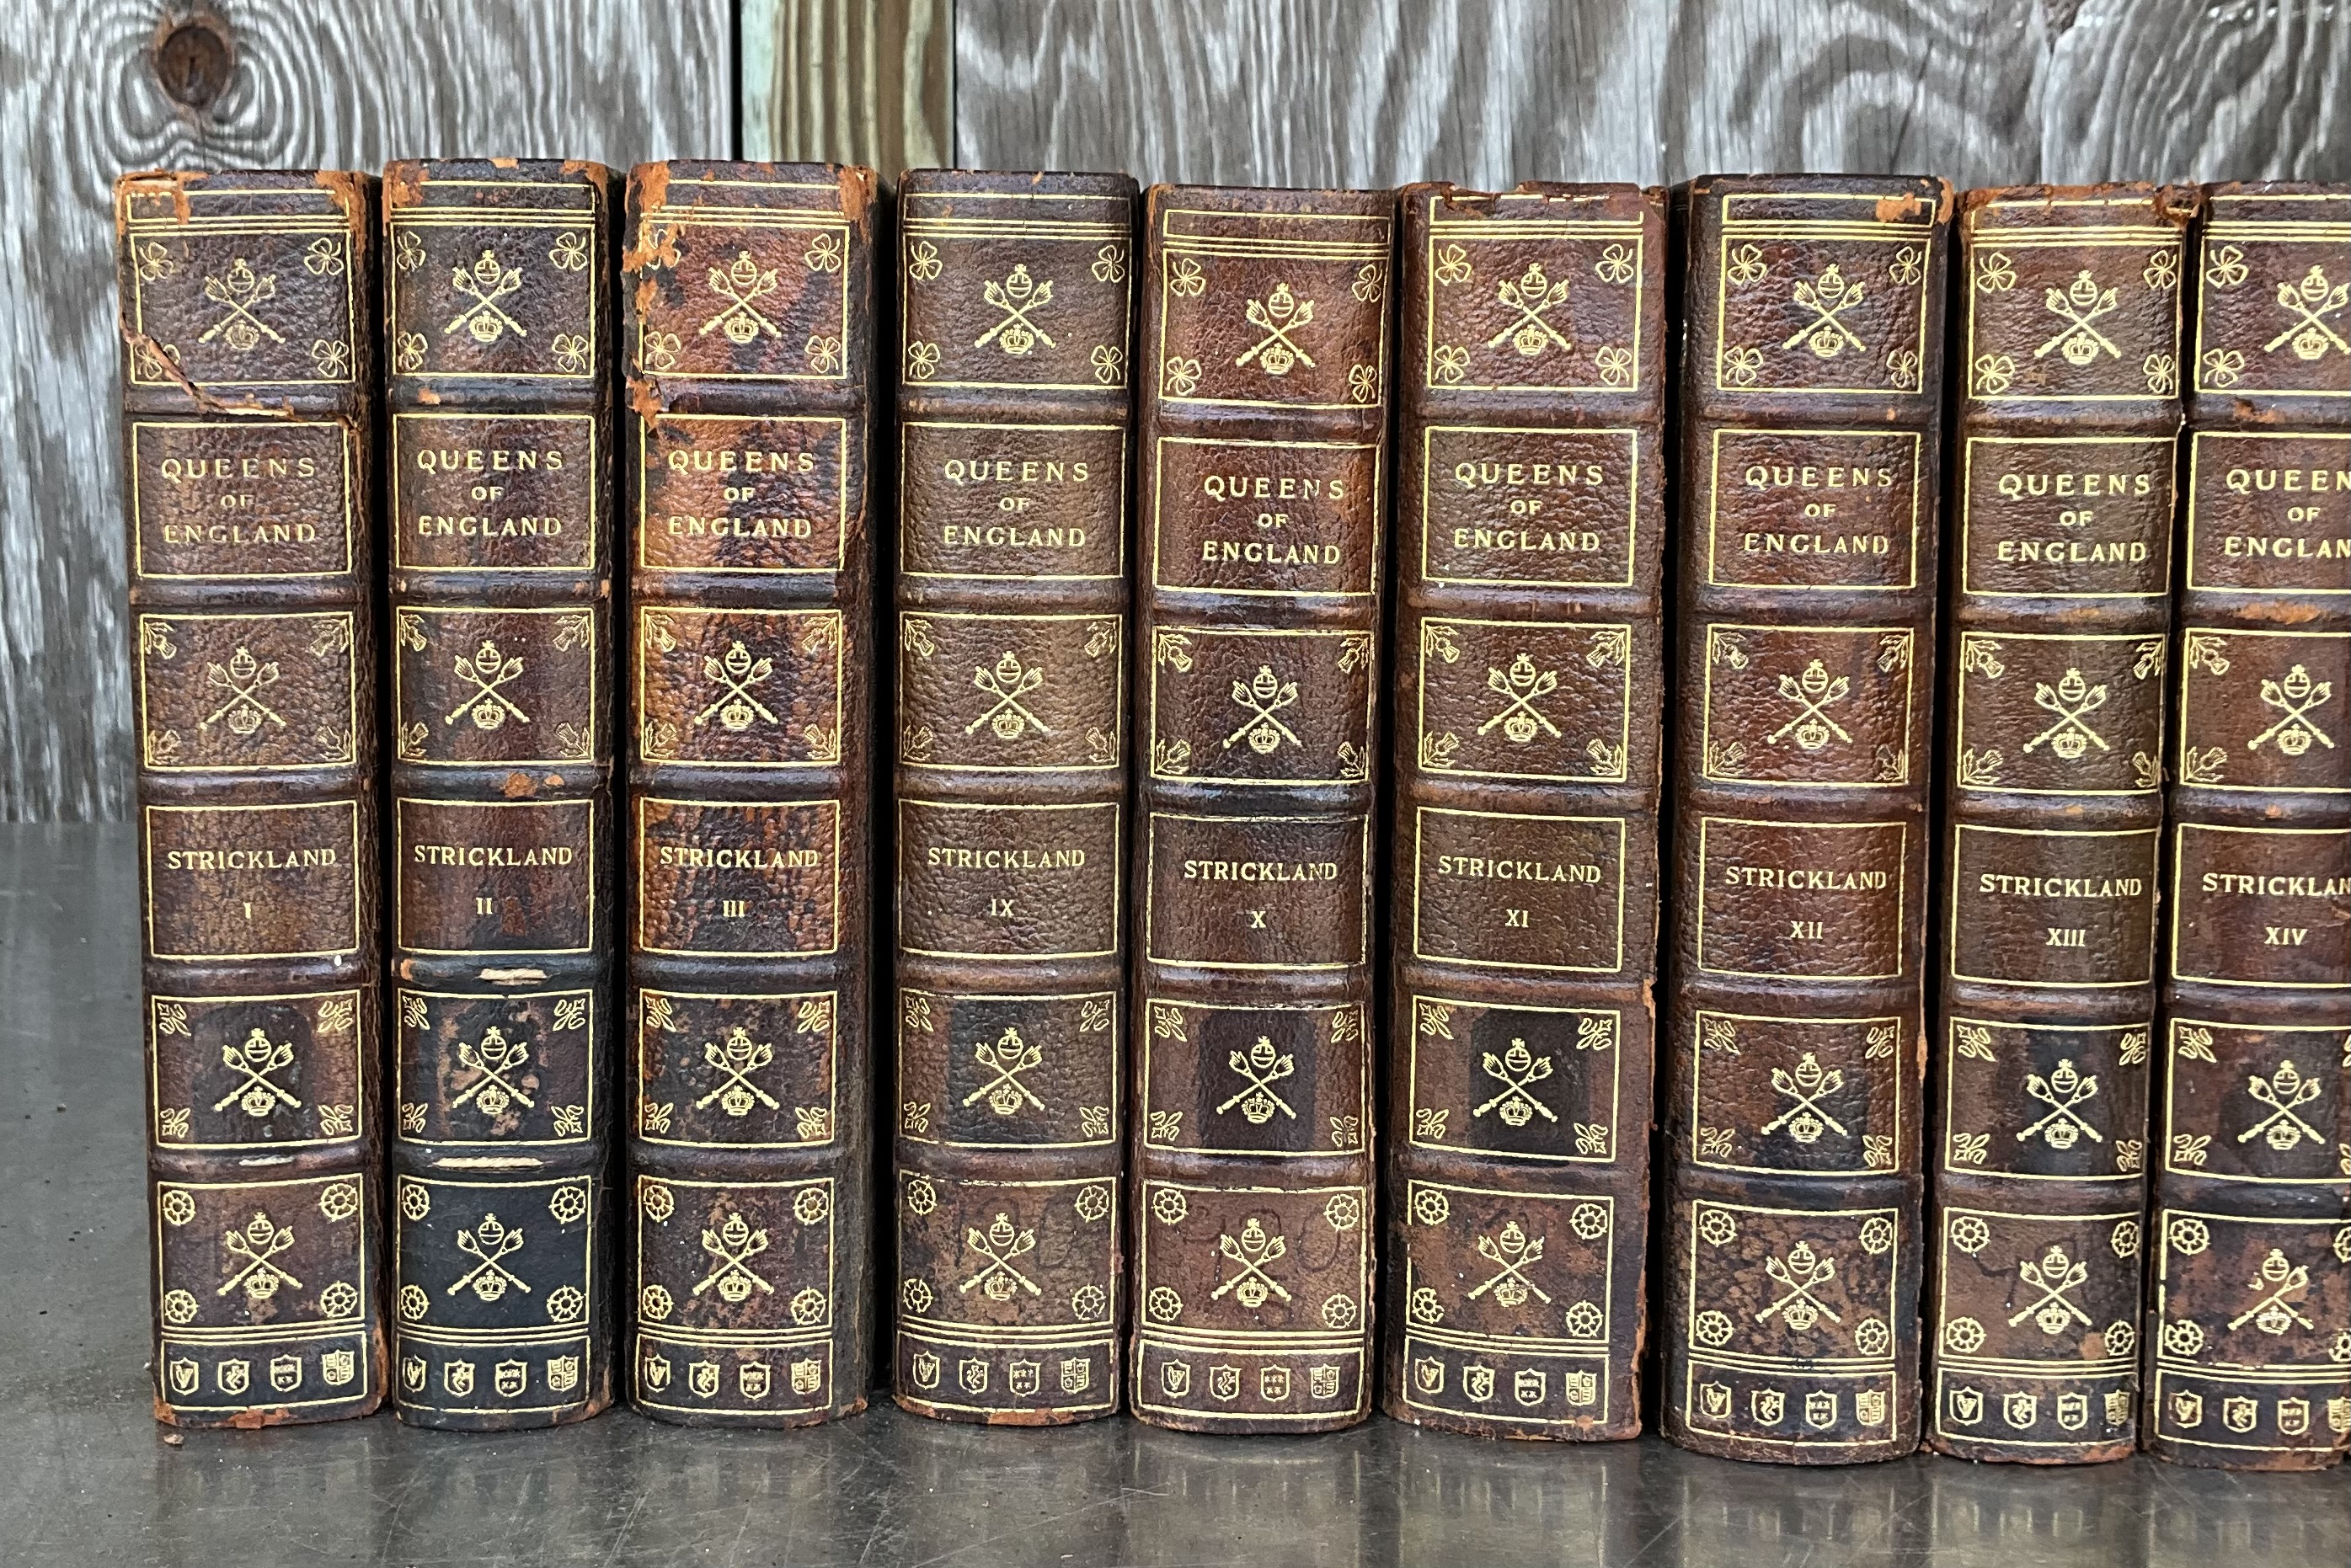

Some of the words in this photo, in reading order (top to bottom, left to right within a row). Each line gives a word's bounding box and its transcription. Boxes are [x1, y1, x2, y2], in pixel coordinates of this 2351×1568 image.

[161, 456, 317, 482] QUEENS
[416, 450, 564, 472] QUEENS
[668, 451, 815, 474] QUEENS
[944, 459, 1089, 483] QUEENS
[1455, 462, 1604, 486] QUEENS
[1745, 466, 1894, 488] QUEENS
[1998, 473, 2151, 496] QUEENS
[471, 486, 503, 501] OF
[724, 487, 754, 502] OF
[1204, 476, 1344, 500] QUEENS
[221, 493, 254, 508] OF
[999, 497, 1031, 511] OF
[1509, 500, 1542, 515] OF
[1804, 504, 1836, 518] OF
[1258, 513, 1286, 528] OF
[2060, 511, 2092, 526] OF
[2287, 507, 2319, 522] OF
[163, 522, 317, 544] ENGLAND
[419, 516, 562, 537] ENGLAND
[669, 516, 812, 538] ENGLAND
[943, 525, 1087, 547] ENGLAND
[1454, 528, 1600, 552] ENGLAND
[1744, 532, 1890, 555] ENGLAND
[1202, 541, 1341, 566] ENGLAND
[1997, 541, 2146, 563] ENGLAND
[168, 849, 337, 870] STRICKLAND
[414, 845, 573, 866] STRICKLAND
[660, 847, 819, 868] STRICKLAND
[927, 848, 1085, 868] STRICKLAND
[1184, 860, 1338, 882] STRICKLAND
[1438, 856, 1601, 883] STRICKLAND
[1725, 867, 1887, 890] STRICKLAND
[1980, 874, 2141, 897] STRICKLAND
[243, 902, 253, 919] I
[476, 898, 494, 915] II
[723, 899, 745, 916] III
[991, 899, 1014, 915] IX
[1250, 910, 1266, 928] X
[1505, 908, 1529, 928] XI
[1790, 921, 1824, 940] XII
[2046, 927, 2086, 947] XIII
[2265, 927, 2307, 945] XIV
